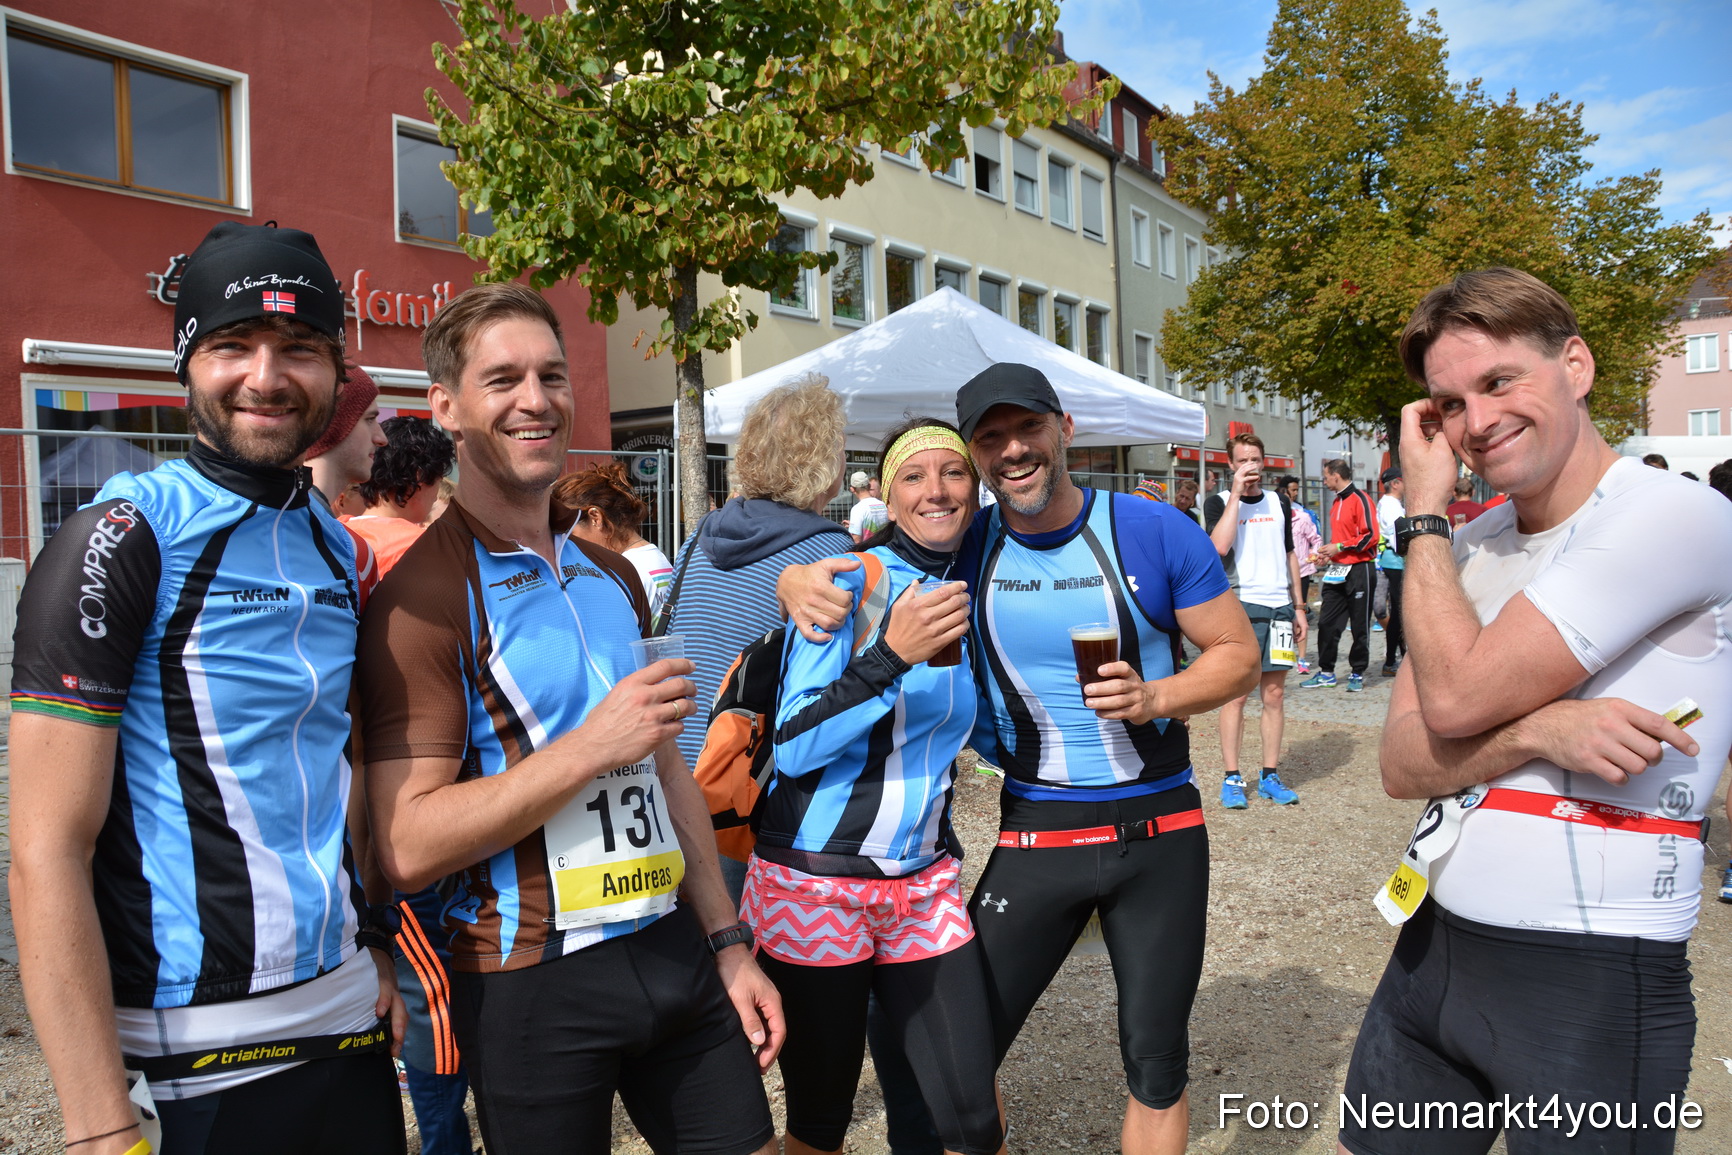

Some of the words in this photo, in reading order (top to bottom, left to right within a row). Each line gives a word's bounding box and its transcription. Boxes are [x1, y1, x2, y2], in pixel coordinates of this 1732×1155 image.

[231, 605, 290, 615] NEUMARKT
[586, 784, 665, 853] 131
[1598, 806, 1639, 820] balance
[1085, 835, 1110, 844] balance
[557, 856, 565, 868] C
[602, 866, 672, 898] Andreas
[221, 1045, 296, 1064] triathlon
